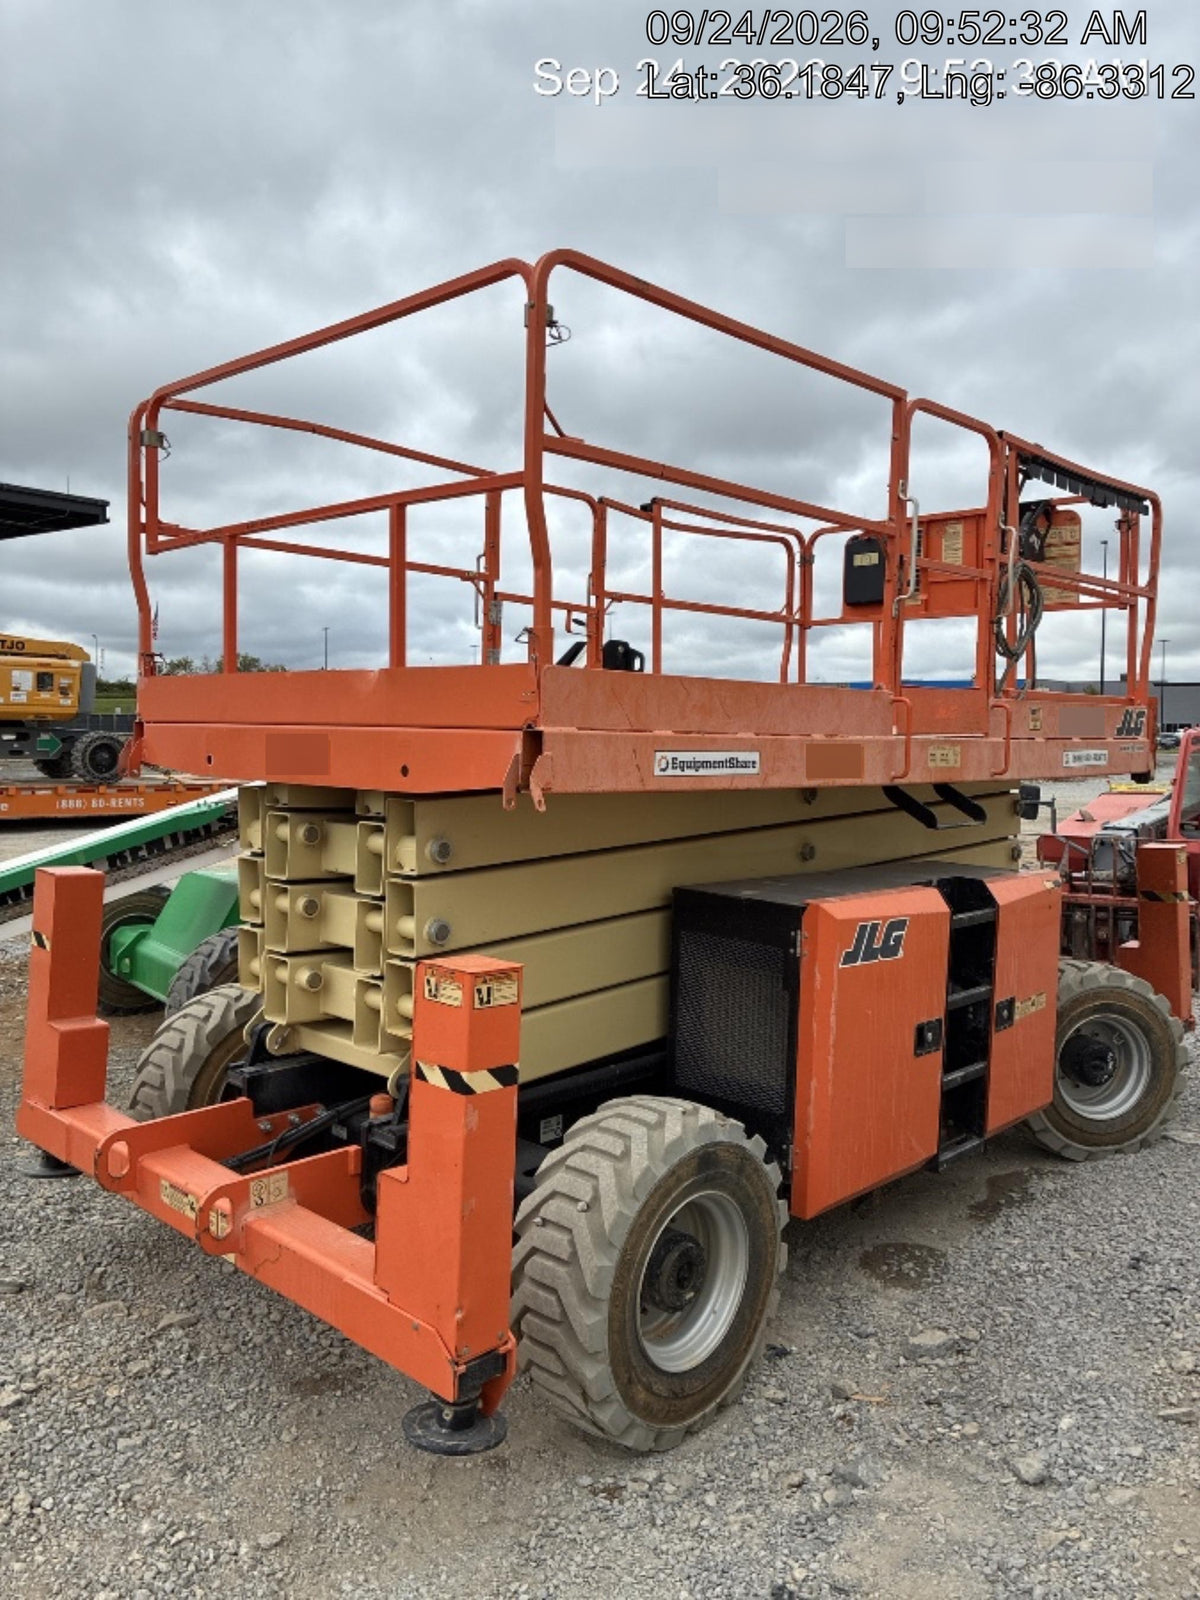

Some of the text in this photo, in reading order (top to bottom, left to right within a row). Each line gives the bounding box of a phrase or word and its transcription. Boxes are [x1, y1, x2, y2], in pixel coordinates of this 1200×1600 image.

[1116, 707, 1147, 737] JLG
[671, 756, 757, 772] EquipmentShare
[839, 916, 910, 968] JLG
